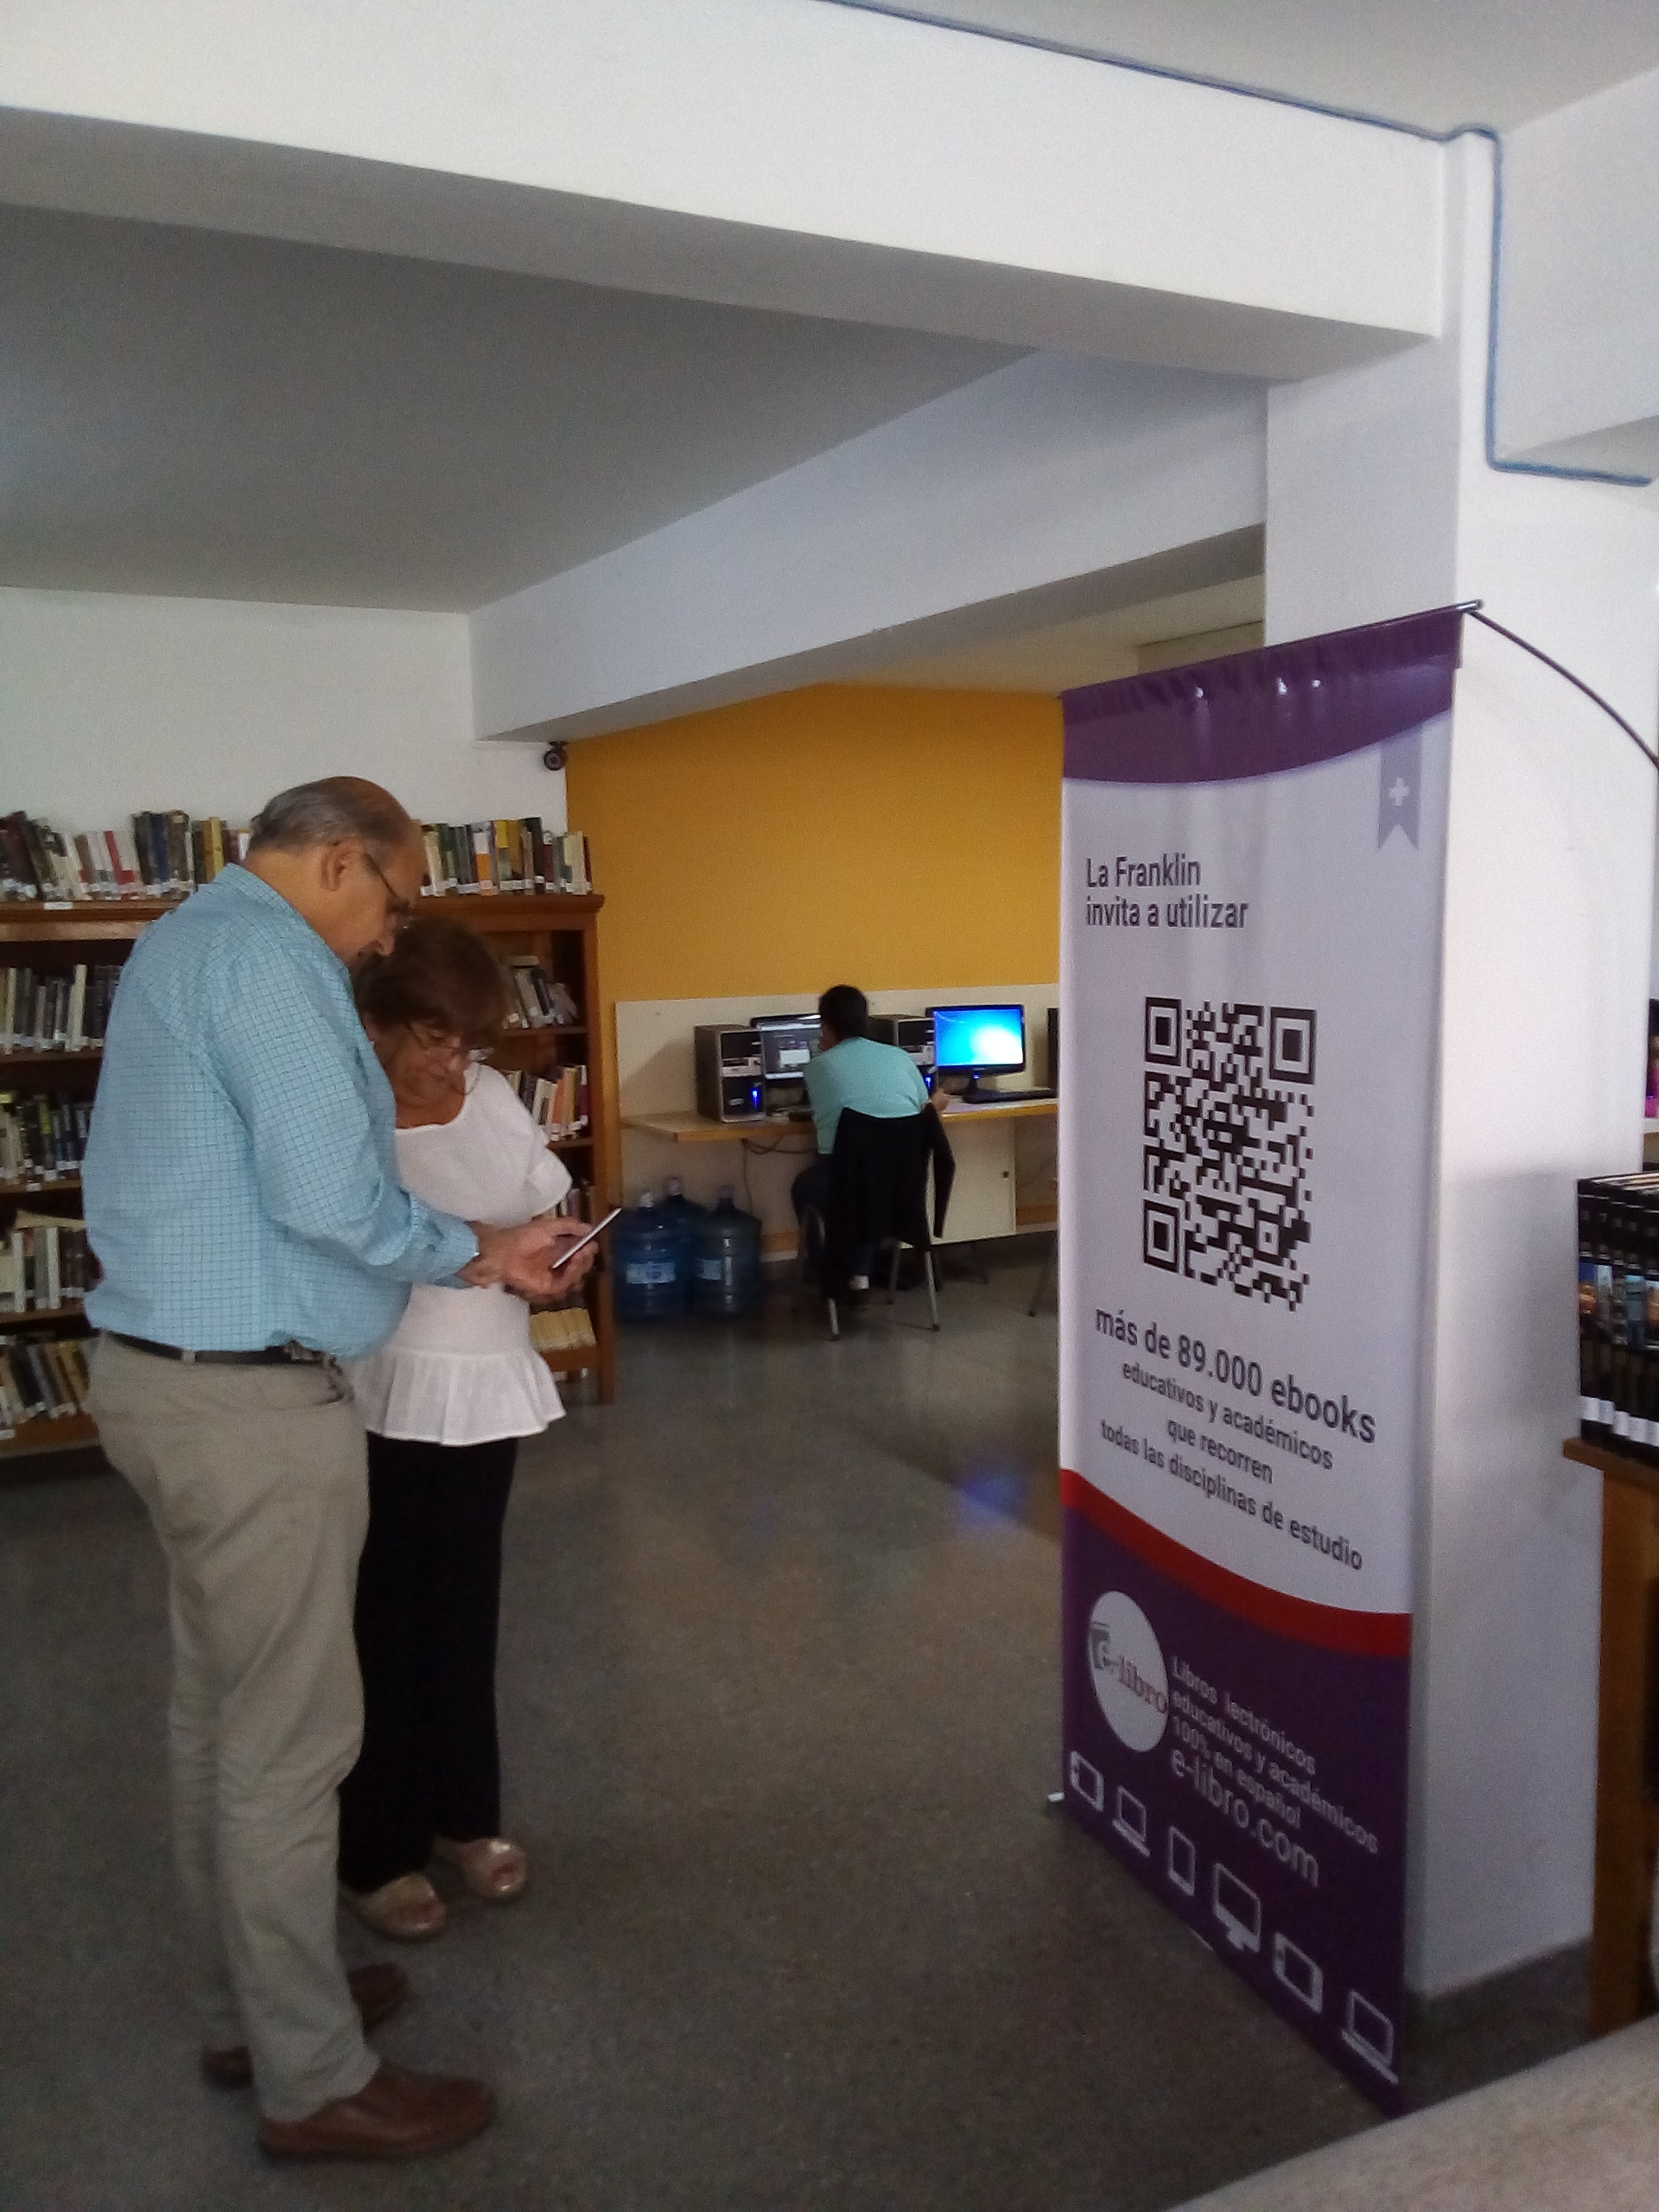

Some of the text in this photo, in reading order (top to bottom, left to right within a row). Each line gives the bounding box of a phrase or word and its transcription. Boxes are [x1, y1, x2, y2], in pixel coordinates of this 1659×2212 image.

[1086, 852, 1201, 887] La Franklin
[1086, 893, 1249, 928] invita a utilizar
[1095, 1308, 1376, 1443] más de 89.000 ebooks
[1122, 1362, 1334, 1470] educativos y académicos
[1099, 1419, 1363, 1571] todas las disciplinas de estudio
[1167, 1420, 1274, 1484] que recorren
[1172, 1656, 1218, 1705] Libros
[1172, 1690, 1380, 1855] educativos y académicos
[1213, 1751, 1234, 1777] en
[1170, 1749, 1320, 1888] e-libro.com
